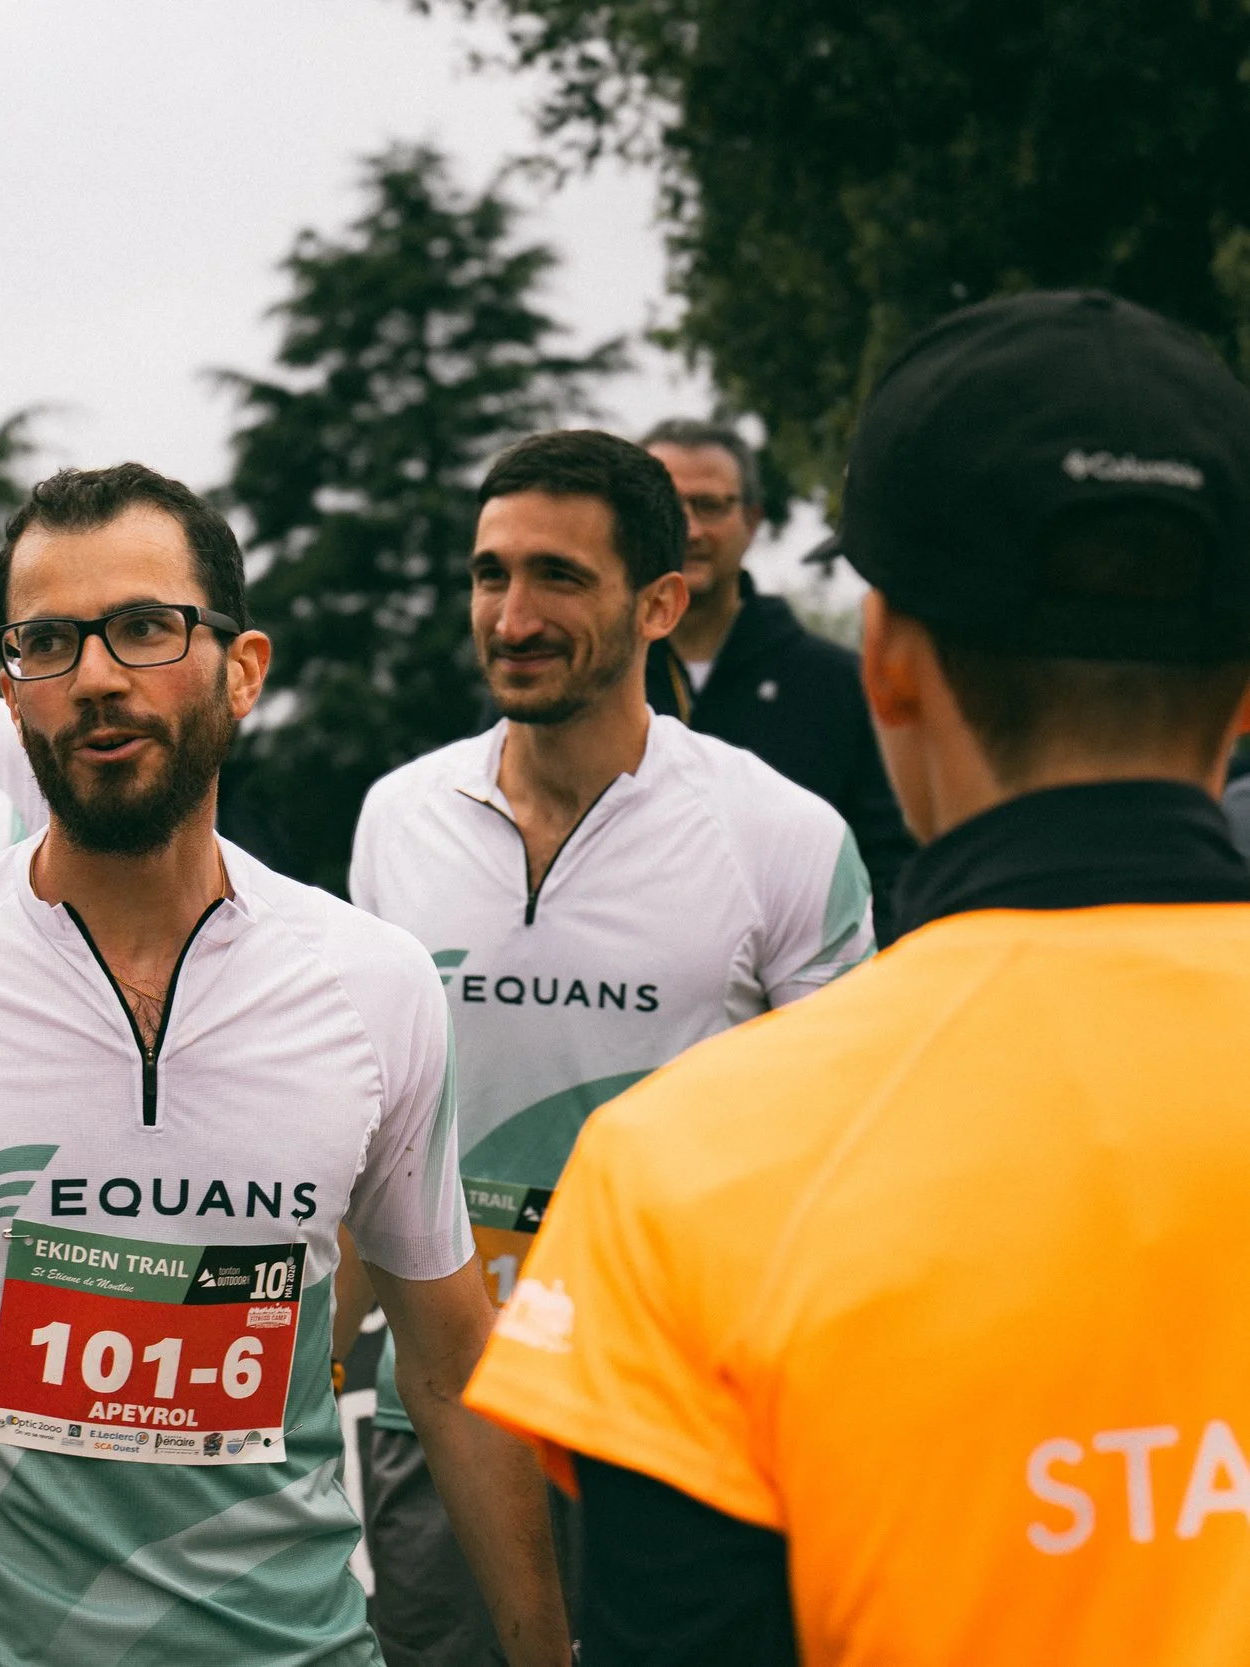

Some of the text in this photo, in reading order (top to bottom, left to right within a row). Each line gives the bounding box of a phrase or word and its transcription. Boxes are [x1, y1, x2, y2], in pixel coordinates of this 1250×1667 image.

[463, 975, 659, 1012] EQUANS
[51, 1177, 317, 1220] EQUANS
[469, 1190, 518, 1212] TRAIL
[35, 1239, 189, 1279] EKIDEN TRAIL
[250, 1262, 287, 1299] 10
[31, 1321, 264, 1400] 101-6
[88, 1400, 199, 1427] APEYROL
